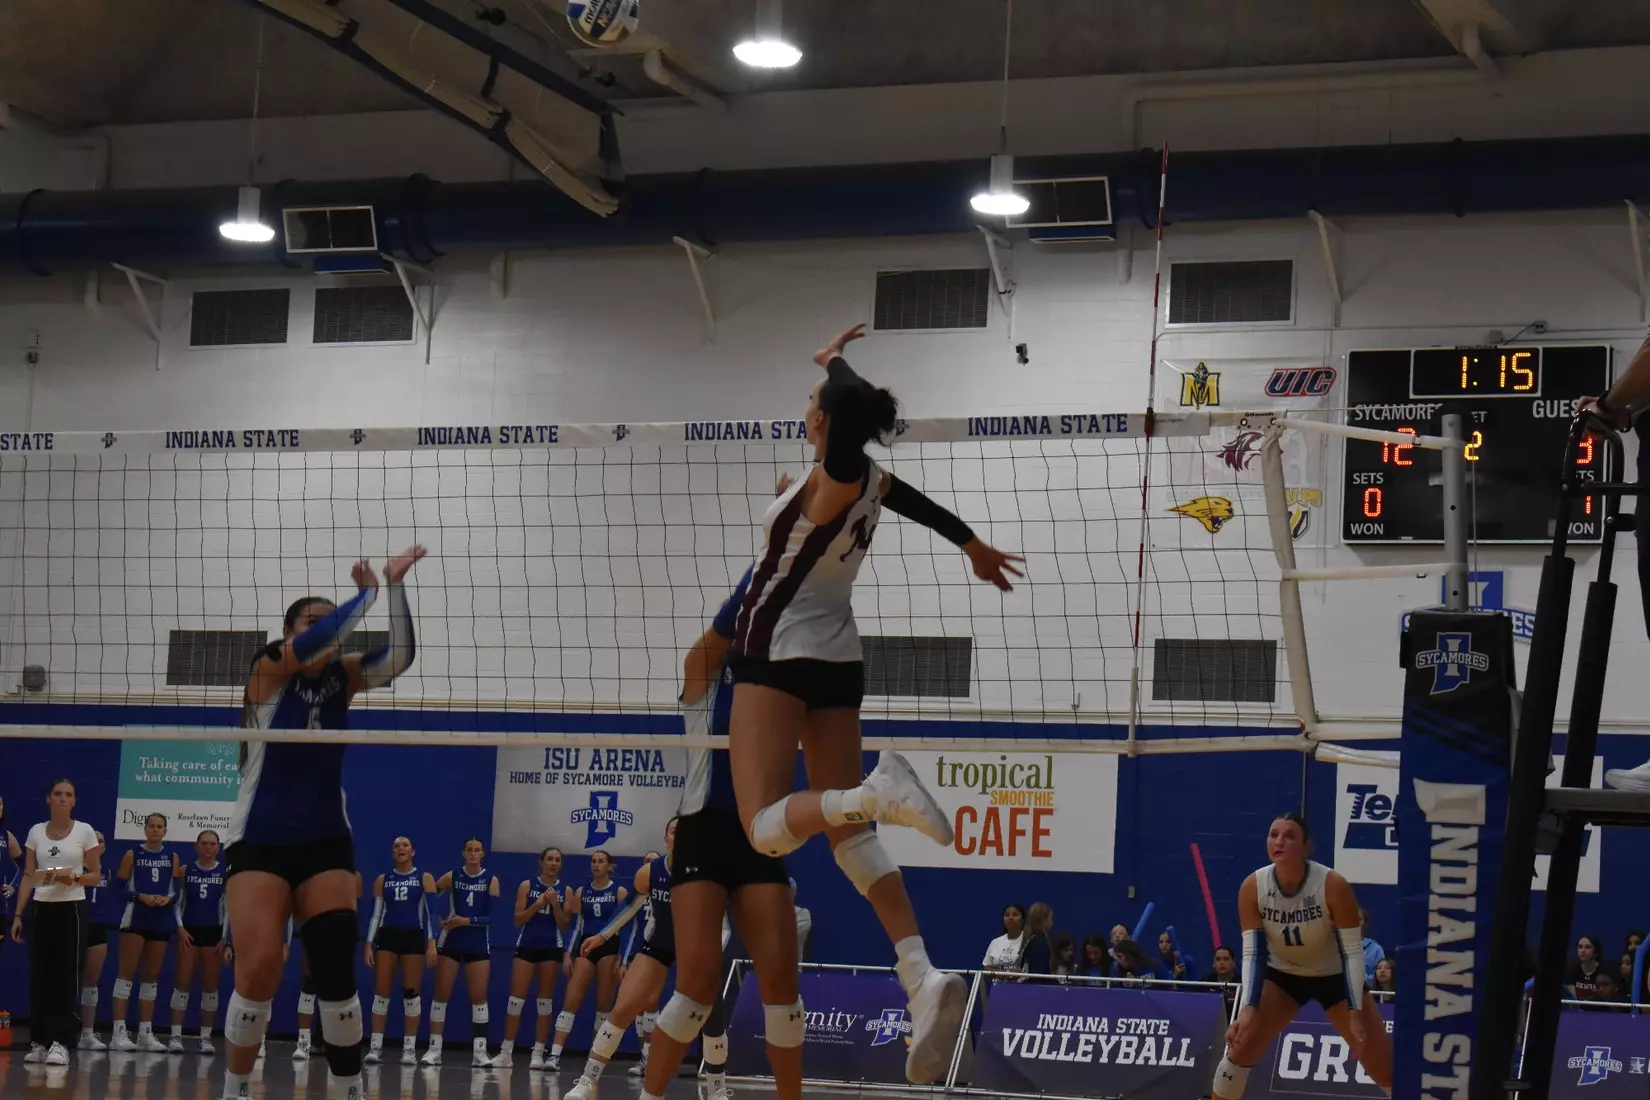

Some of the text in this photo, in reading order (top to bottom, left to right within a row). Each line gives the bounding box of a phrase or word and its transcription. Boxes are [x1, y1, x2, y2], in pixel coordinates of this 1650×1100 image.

[1461, 352, 1533, 391] 1:15
[1265, 367, 1336, 397] UIC
[1353, 402, 1443, 421] SYCAMORE
[1471, 411, 1488, 423] ET
[1532, 399, 1578, 419] GUES
[684, 420, 807, 441] INDIANA STA
[967, 413, 1129, 437] INDIANA STATE
[0, 432, 54, 451] STATE
[165, 429, 300, 450] INDIANA STATE
[417, 424, 559, 446] INDIANA STATE
[1463, 431, 1483, 461] 2
[1352, 472, 1384, 485] SETS
[1363, 487, 1382, 518] 0
[1350, 523, 1384, 535] WON
[1417, 652, 1487, 669] SYCAMORES
[139, 757, 179, 773] Taking
[182, 761, 207, 770] care
[210, 759, 223, 770] of
[544, 747, 666, 772] ISU ARENA
[135, 771, 162, 783] what
[165, 774, 234, 788] community
[509, 771, 686, 788] HOME OF SYCAMORE VOLLEYBA
[936, 755, 1055, 795] tropical
[990, 790, 1055, 806] SMOOTHIE
[178, 813, 209, 821] Roselawn
[196, 821, 230, 829] Memorial
[571, 809, 633, 825] SYCAMORES
[954, 805, 1054, 857] CAFE
[136, 859, 172, 867] SYCAMORES
[151, 867, 159, 883] 9
[186, 876, 223, 885] SYCAMORES
[199, 884, 208, 899] 5
[384, 880, 420, 888] SYCAMORES
[454, 881, 488, 892] SYCAMORES
[394, 886, 408, 901] 12
[465, 892, 474, 907] 4
[1412, 777, 1487, 1021] INDIANA
[592, 903, 602, 918] 8
[1261, 905, 1323, 924] SYCAMORES
[1281, 926, 1305, 947] 11
[867, 1019, 911, 1032] SYCAMORES
[1036, 1013, 1170, 1036] INDIANA STATE
[1002, 1027, 1195, 1068] VOLLEYBALL
[1569, 1057, 1622, 1072] SYCAMORES
